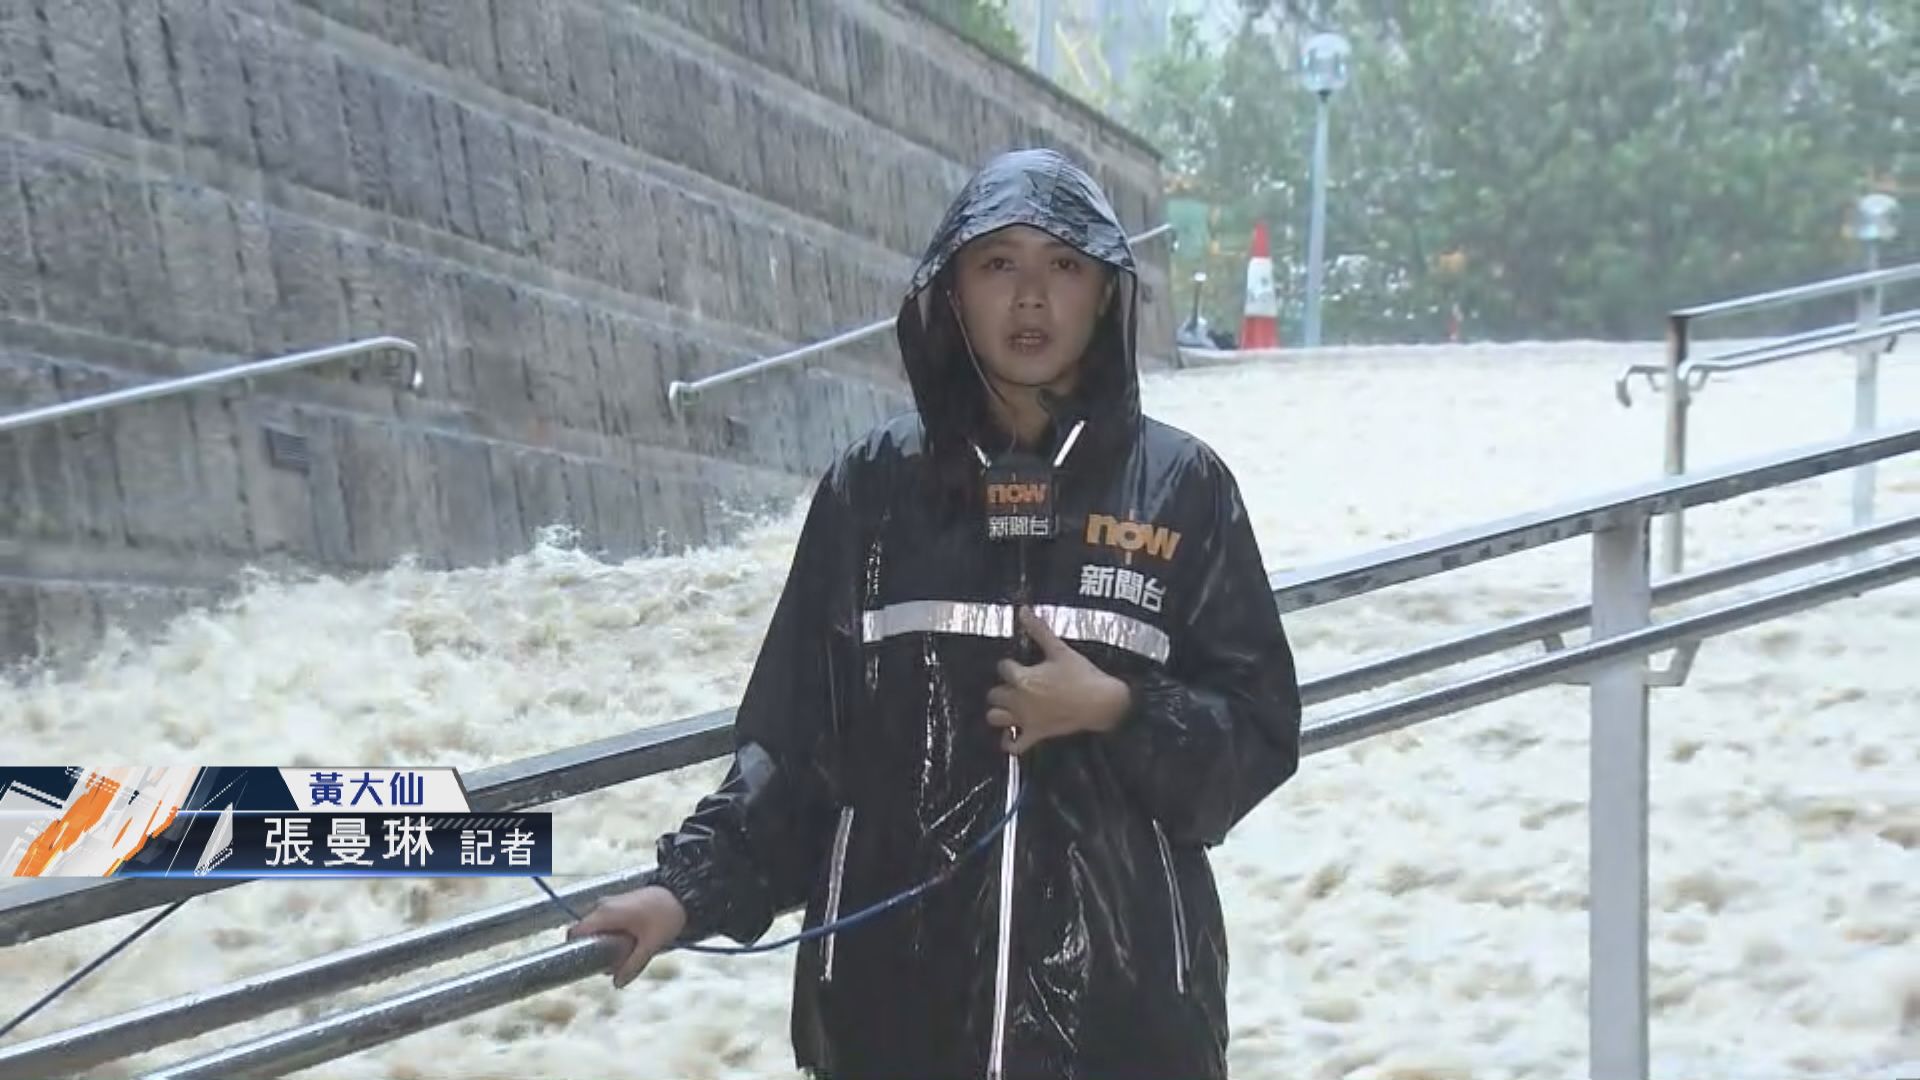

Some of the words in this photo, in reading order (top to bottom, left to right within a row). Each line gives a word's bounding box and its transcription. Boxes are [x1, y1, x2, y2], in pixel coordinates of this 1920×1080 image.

[987, 484, 1047, 504] now
[988, 516, 1049, 537] 新聞台
[1086, 513, 1181, 560] now
[1079, 564, 1166, 613] 新聞台
